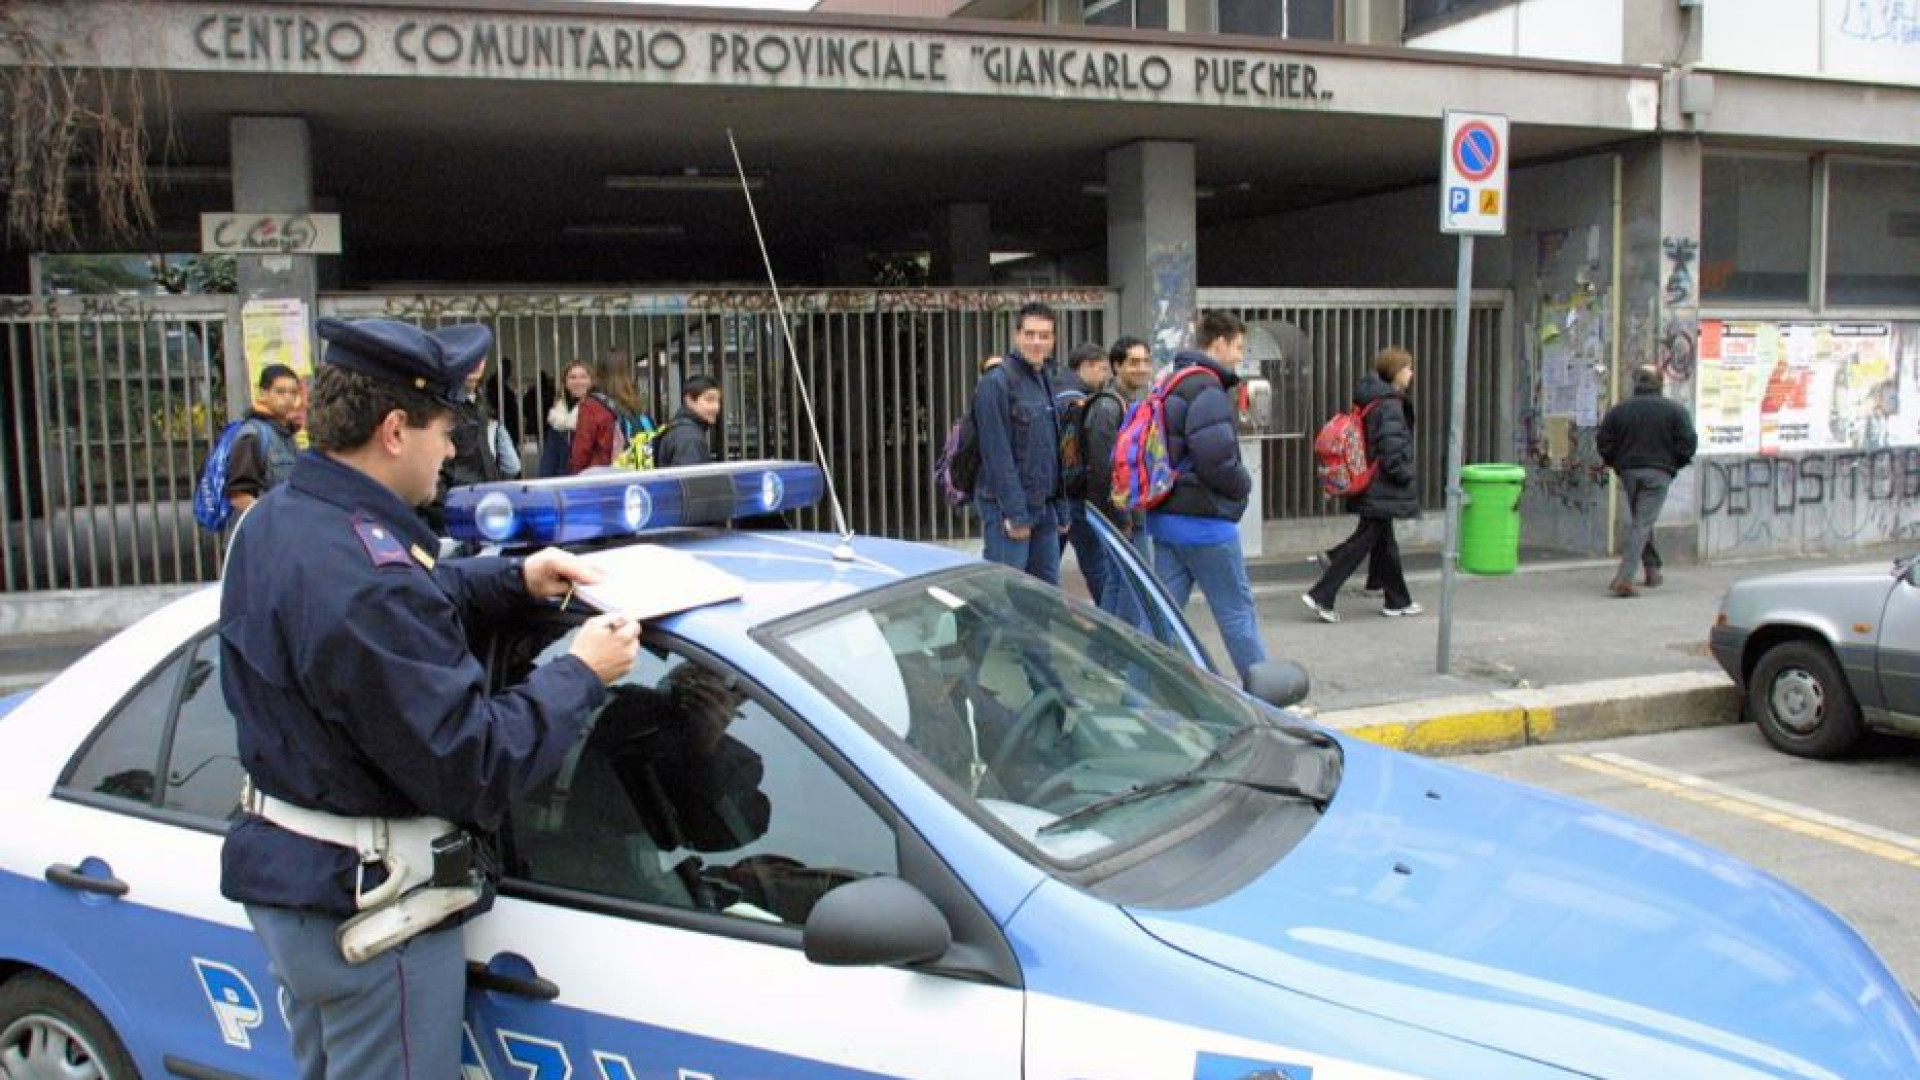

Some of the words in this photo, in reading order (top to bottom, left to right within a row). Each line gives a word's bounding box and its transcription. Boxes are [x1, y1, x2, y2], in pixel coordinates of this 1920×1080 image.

[195, 15, 367, 63] CENTRO
[394, 22, 686, 71] COMUNITARIO
[709, 33, 947, 82] PROVINCIALE
